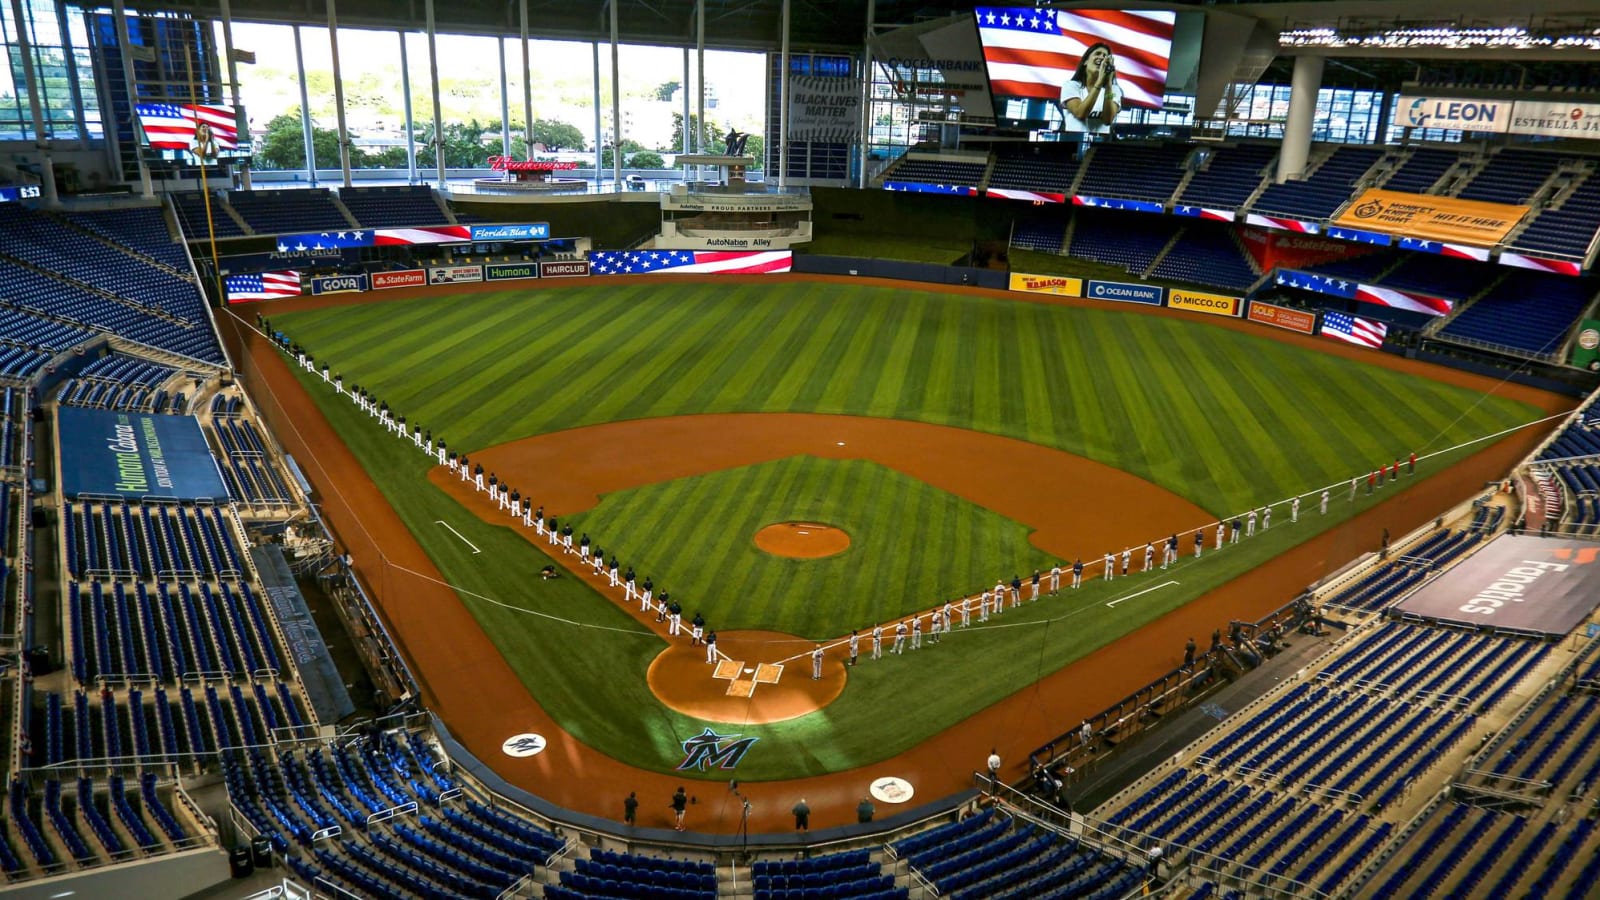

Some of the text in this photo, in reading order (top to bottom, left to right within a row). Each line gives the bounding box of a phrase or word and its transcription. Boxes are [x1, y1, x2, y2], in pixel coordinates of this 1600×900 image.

[794, 93, 858, 107] BLACK LIVES
[805, 105, 847, 117] MATTER
[1435, 101, 1497, 122] LEON
[1514, 117, 1579, 130] ESTRELLA
[20, 186, 40, 198] 6:53
[1384, 209, 1416, 217] KNIFE
[1390, 202, 1436, 214] MONKEY
[1378, 214, 1412, 223] FIGHT
[1433, 212, 1458, 220] HIT
[1470, 217, 1507, 227] HERE
[475, 228, 528, 237] Florida Blue
[707, 238, 771, 247] AutoNation Alley
[491, 268, 530, 277] Humana
[546, 265, 585, 274] HAIRCLUB
[323, 278, 357, 291] GOYA
[385, 274, 423, 284] StateFarm
[1106, 287, 1155, 299] OCEAN BANK
[1183, 296, 1229, 309] MICCO.CO
[1253, 304, 1275, 318] SOLIS
[106, 424, 149, 492] Humana Cabana
[1458, 559, 1569, 615] Fanatics
